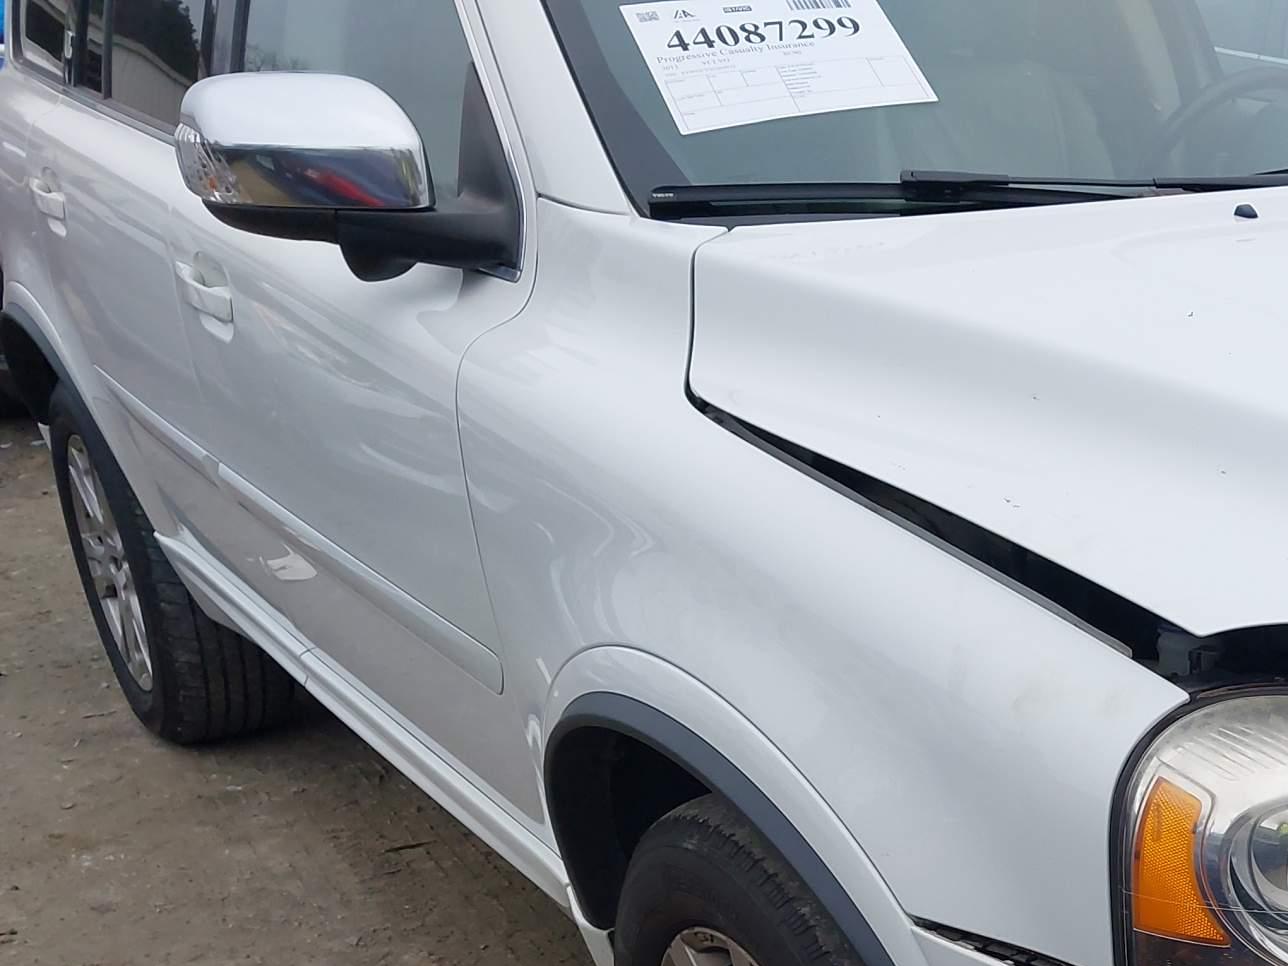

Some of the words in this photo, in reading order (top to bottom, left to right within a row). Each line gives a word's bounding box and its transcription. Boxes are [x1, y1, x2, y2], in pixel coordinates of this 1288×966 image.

[666, 15, 861, 52] 44087299
[656, 50, 718, 64] Progressive
[719, 45, 764, 57] Casualty
[766, 41, 816, 51] Insurance
